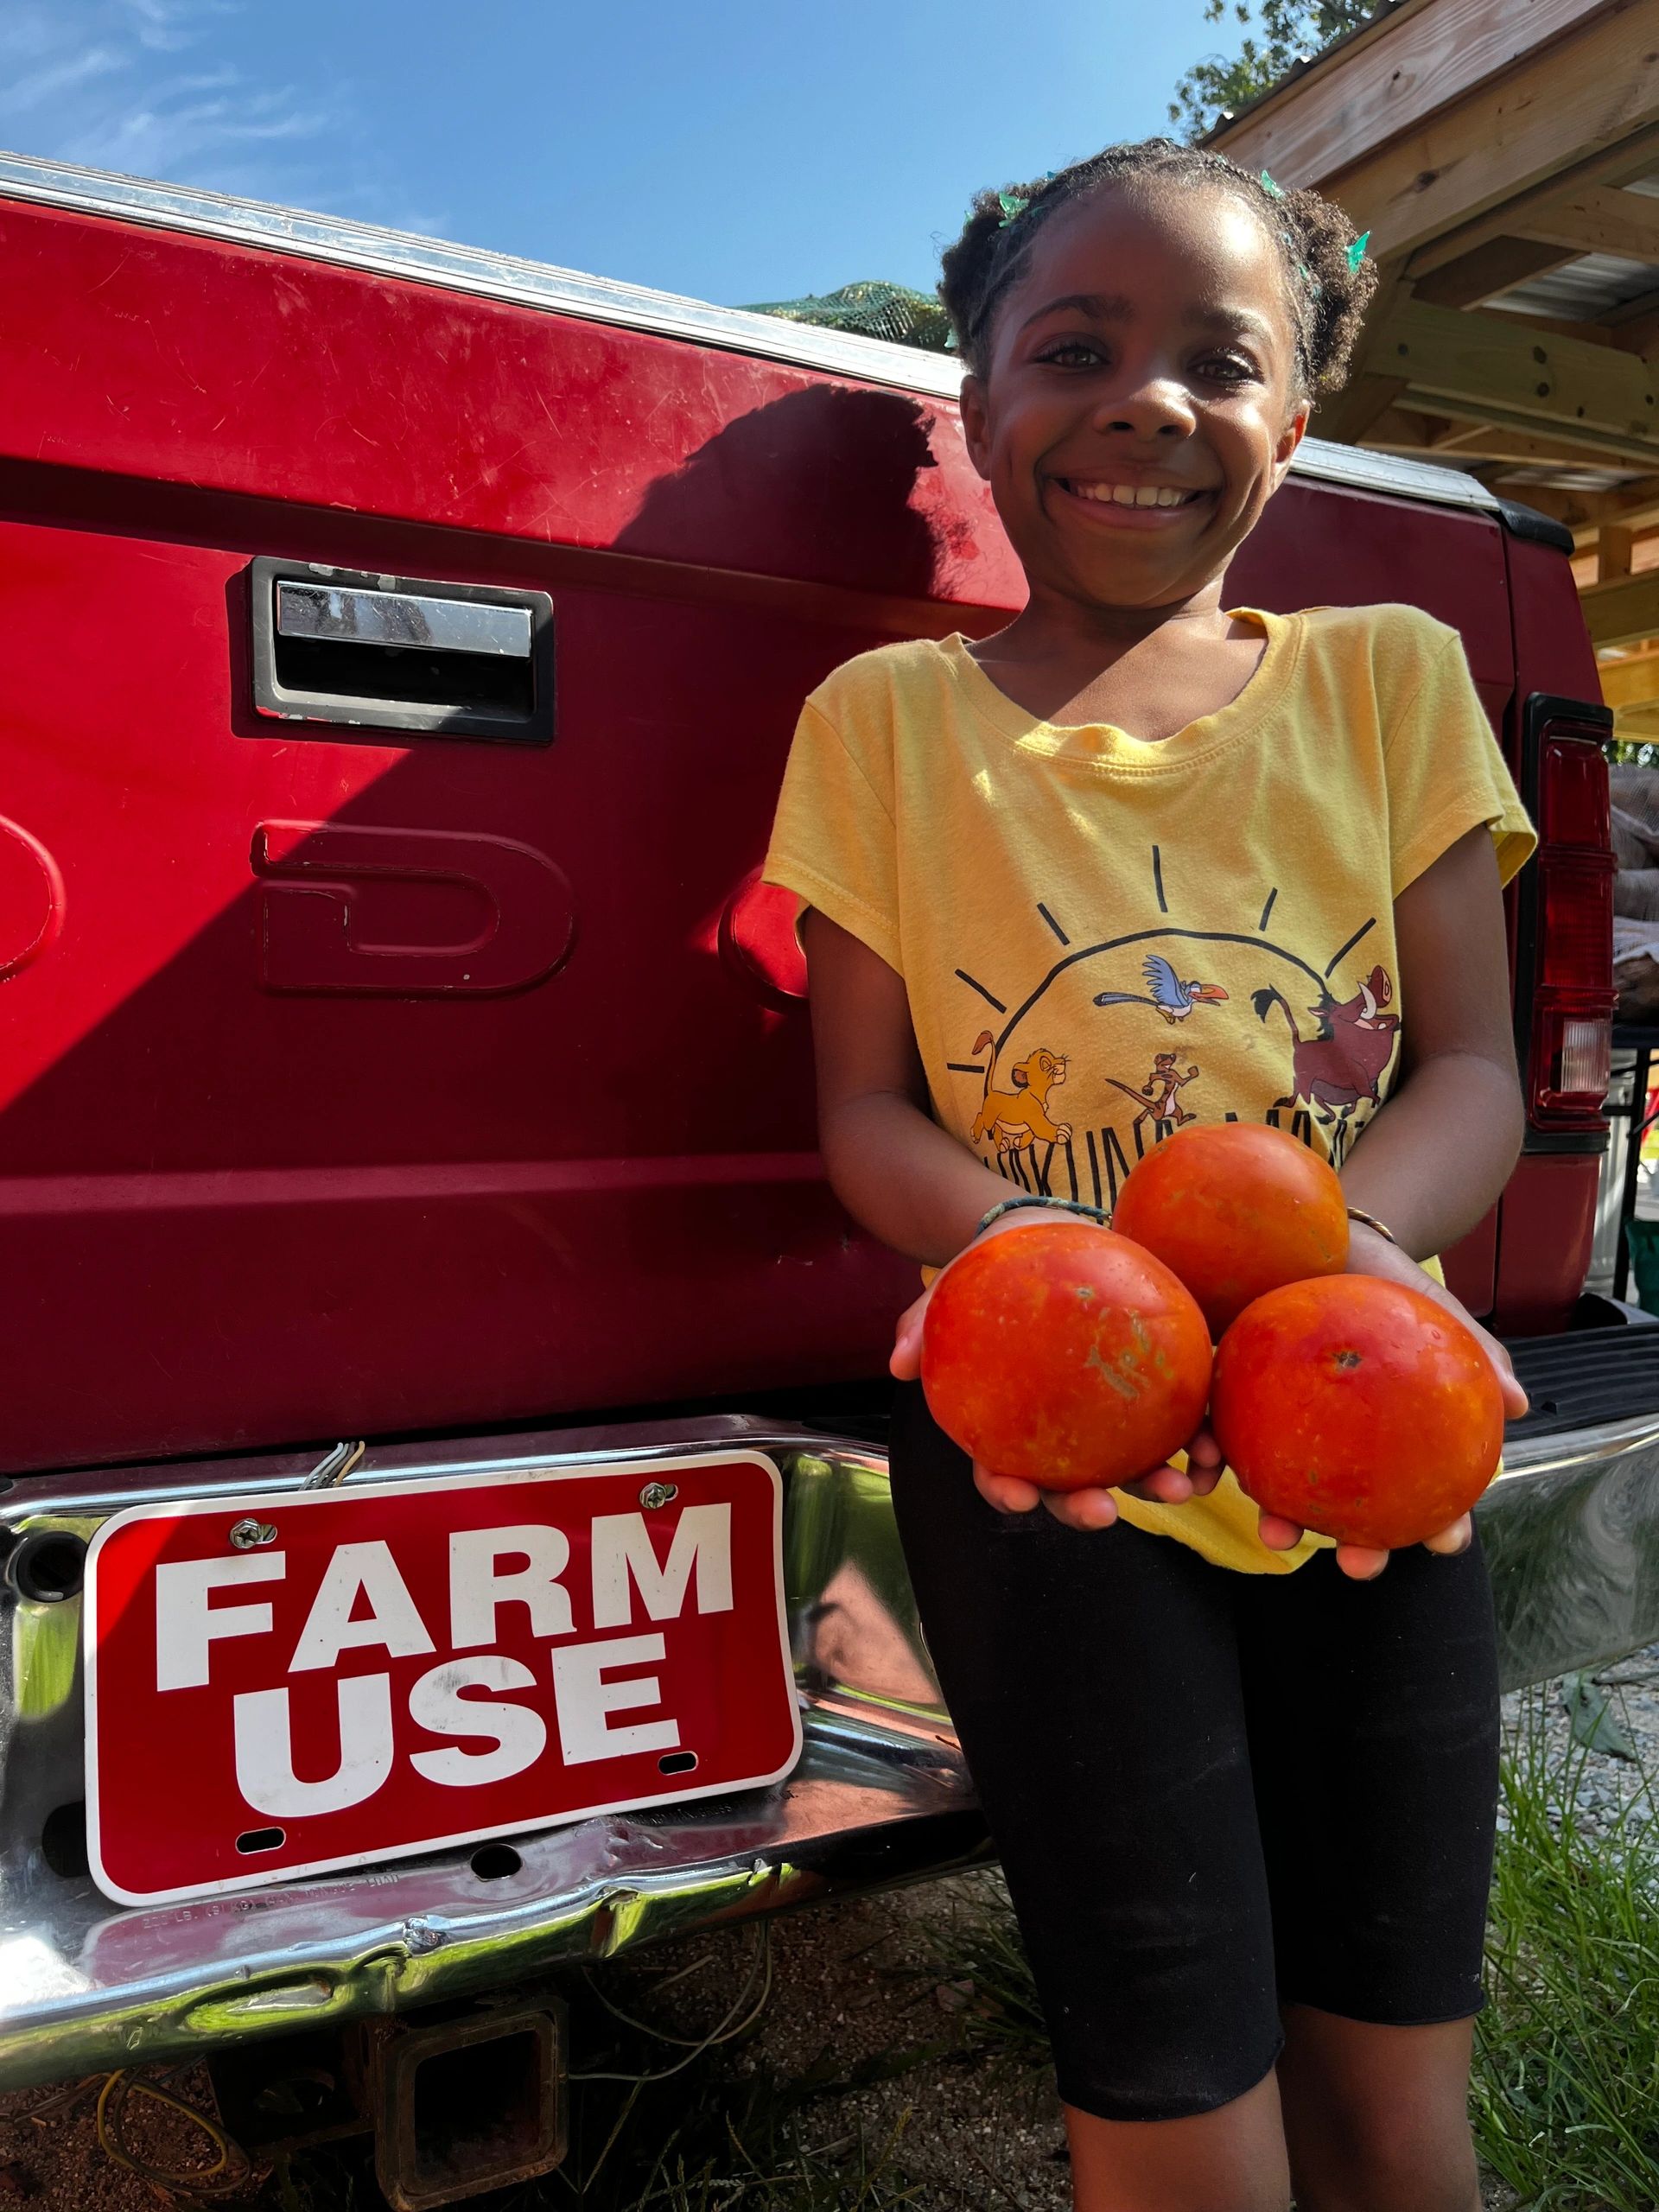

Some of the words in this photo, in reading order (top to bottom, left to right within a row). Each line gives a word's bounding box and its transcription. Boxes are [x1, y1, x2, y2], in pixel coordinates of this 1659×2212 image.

[156, 1502, 734, 1692] FARM
[233, 1631, 681, 1818] USE
[365, 1873, 401, 1888] LOAD
